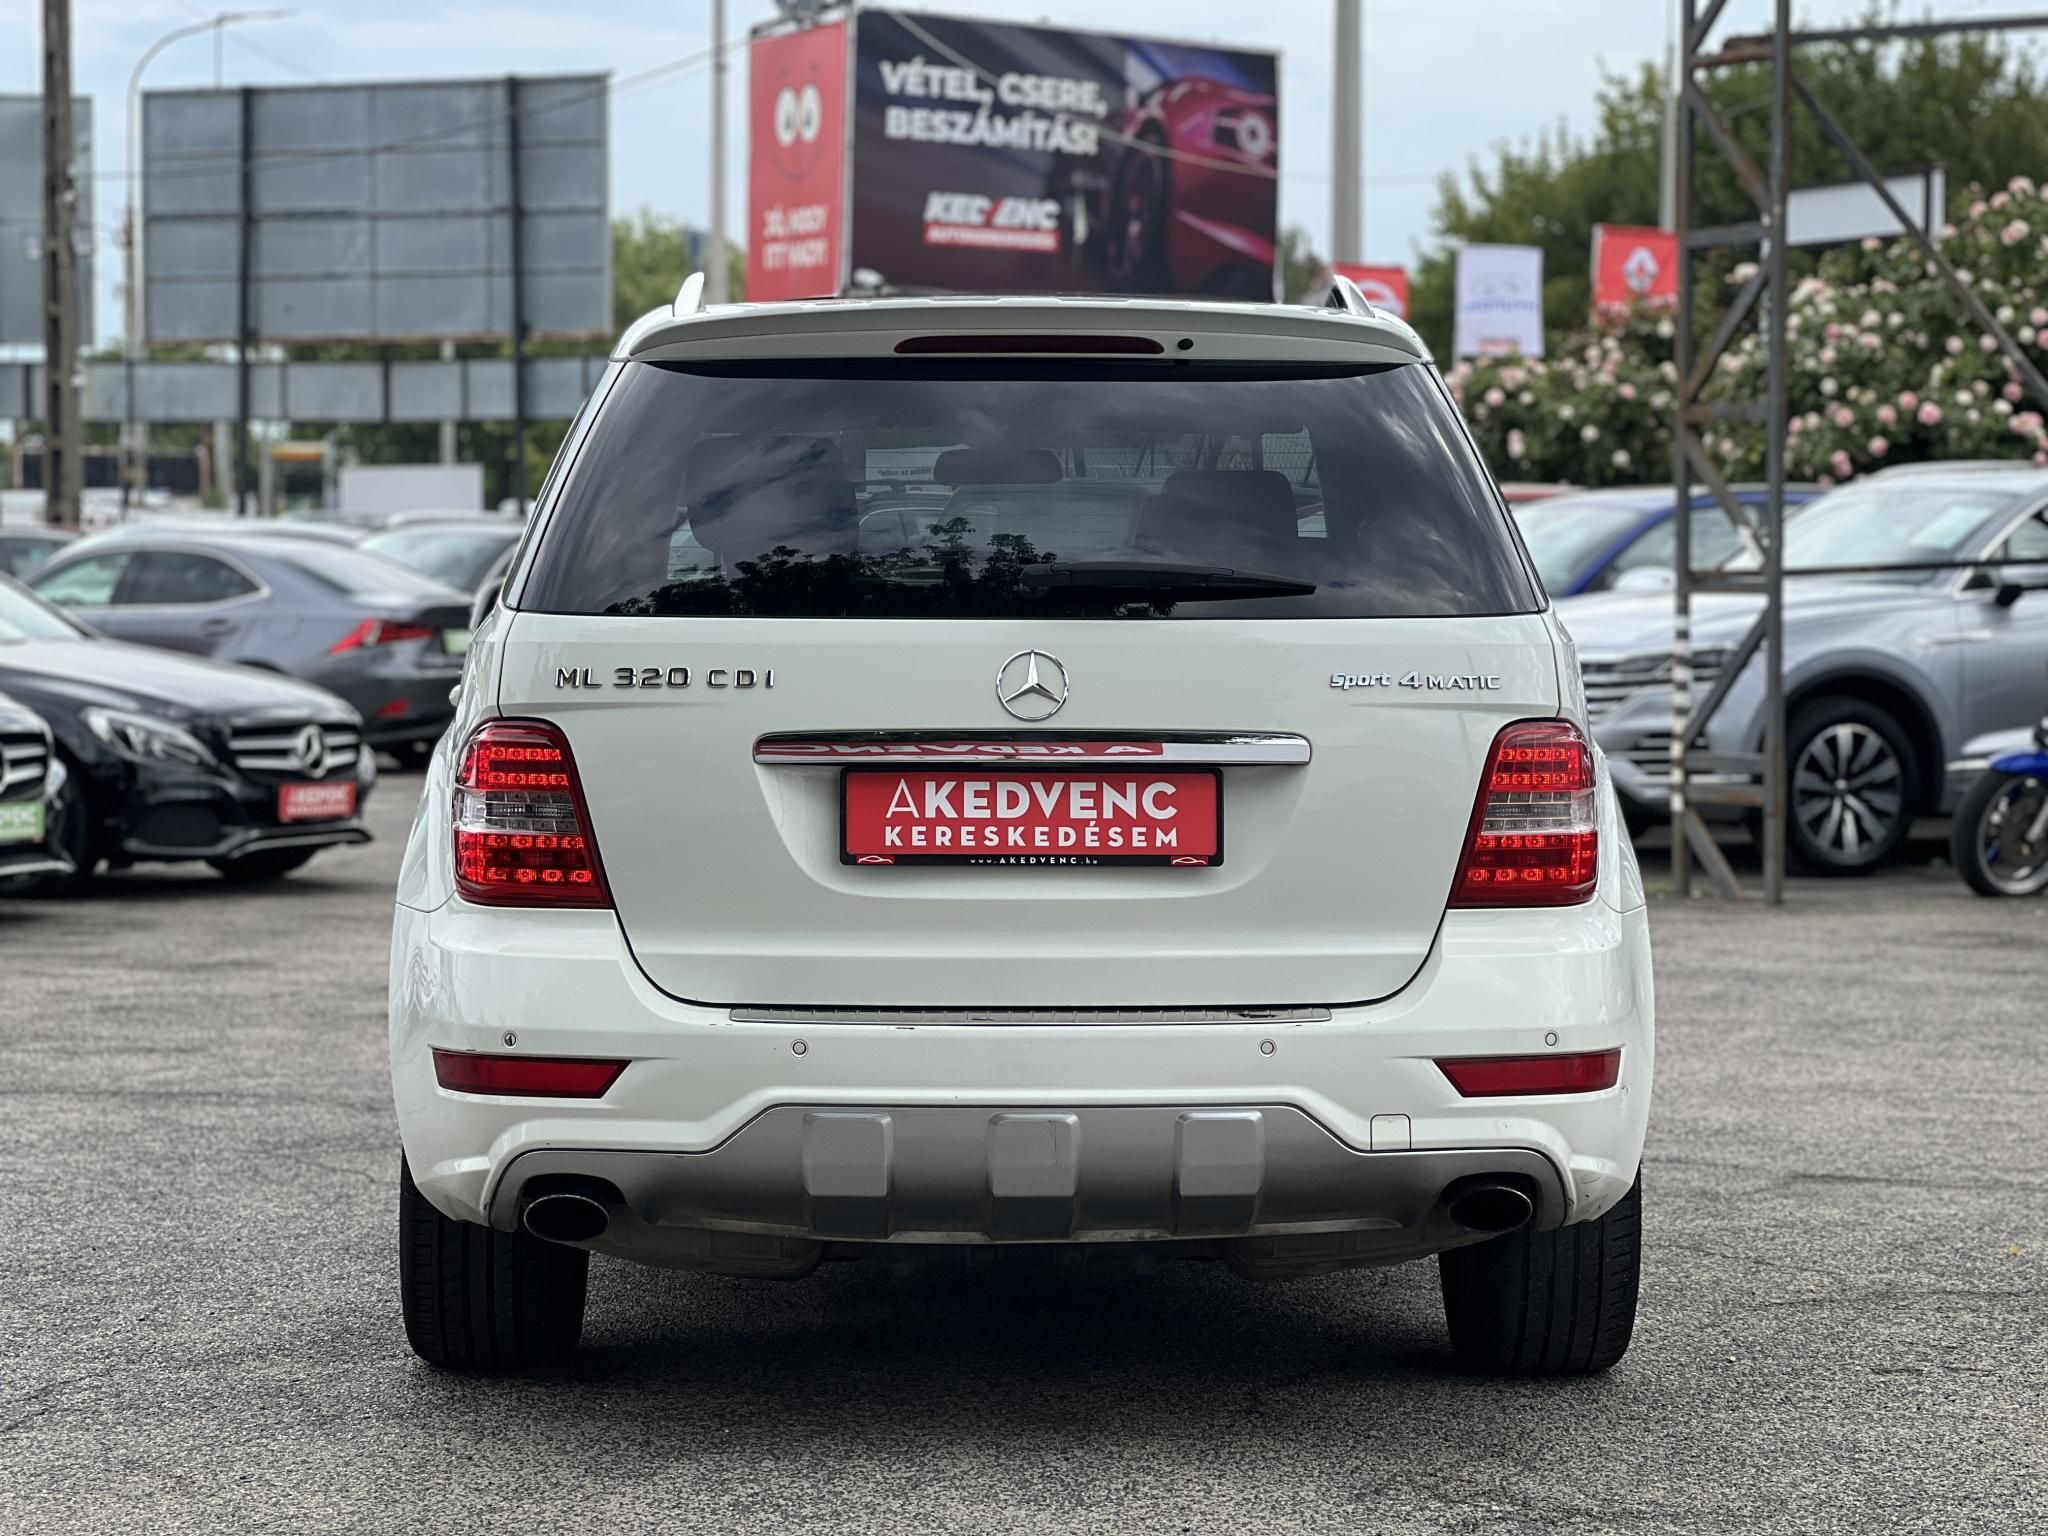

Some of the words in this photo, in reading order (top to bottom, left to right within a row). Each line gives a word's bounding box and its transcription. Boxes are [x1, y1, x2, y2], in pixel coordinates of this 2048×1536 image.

[881, 58, 993, 104] VÉTEL,
[997, 73, 1107, 118] CSERE,
[555, 667, 602, 688] ML
[613, 667, 692, 688] 320
[706, 668, 775, 688] CDI
[1329, 671, 1392, 690] Sport
[884, 820, 1178, 848] KERESKEDÉSEM
